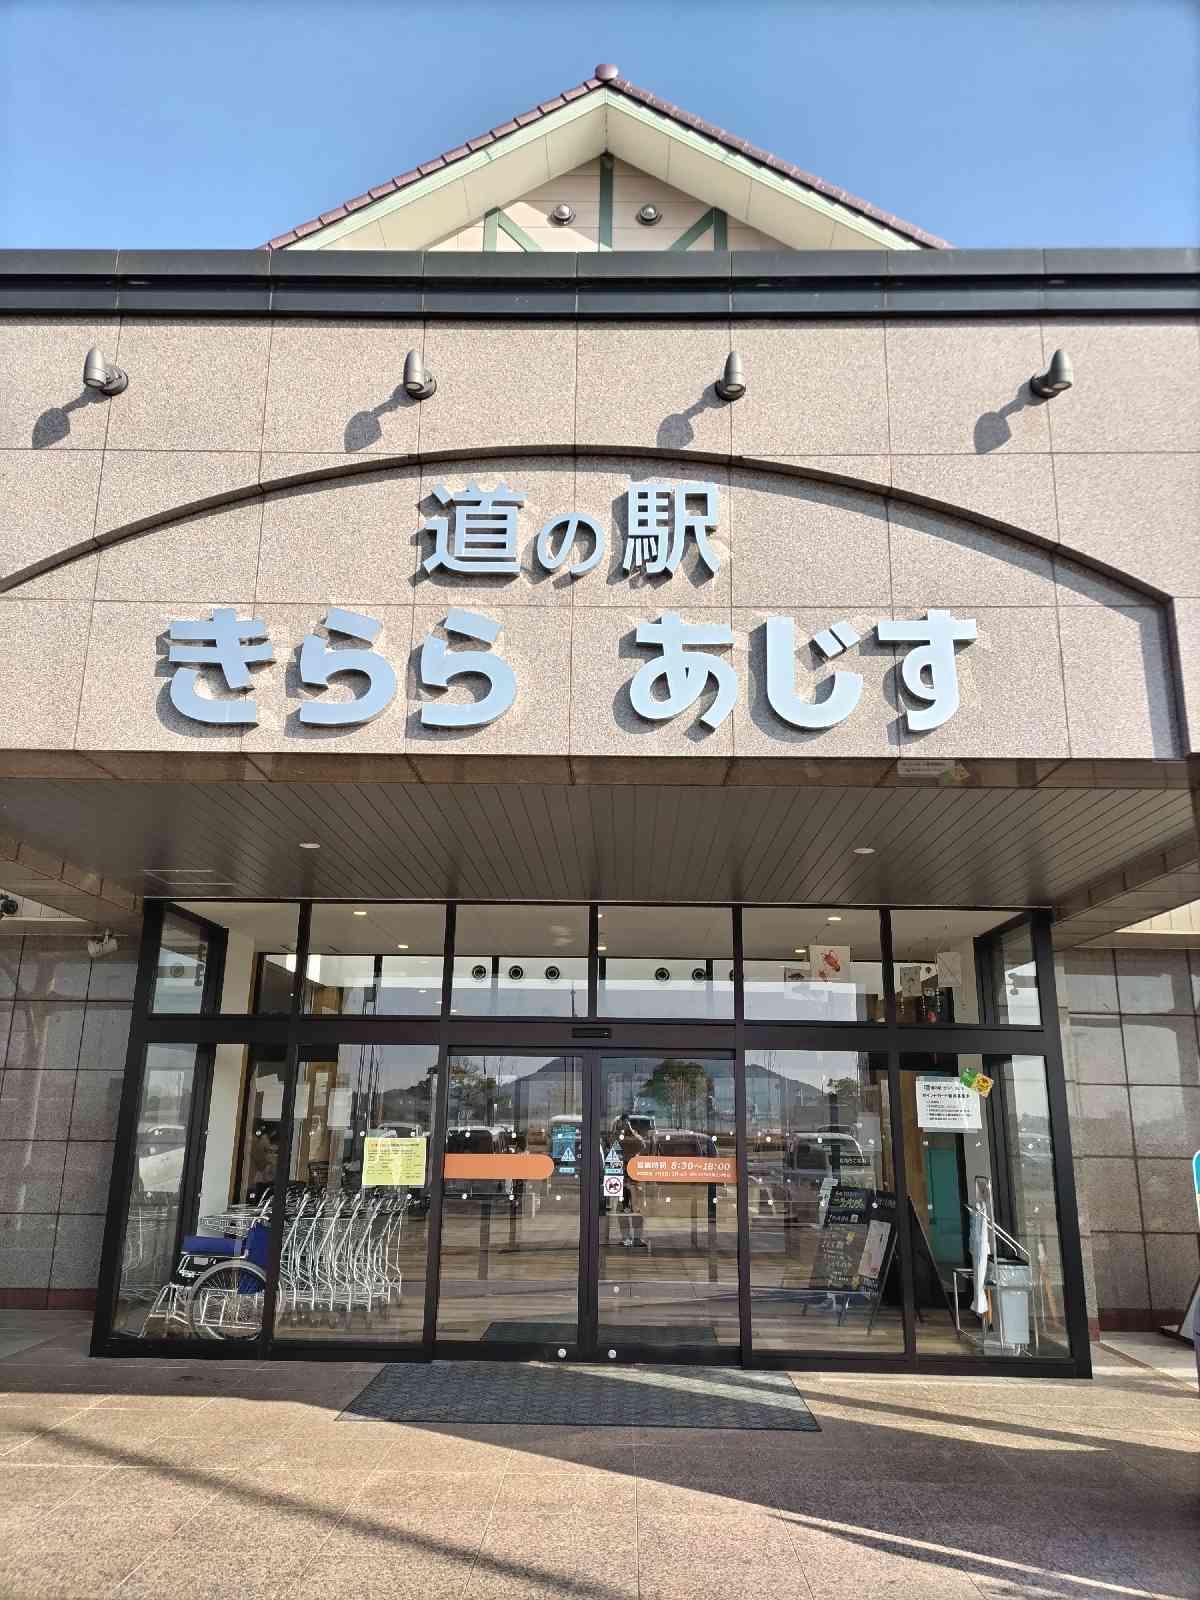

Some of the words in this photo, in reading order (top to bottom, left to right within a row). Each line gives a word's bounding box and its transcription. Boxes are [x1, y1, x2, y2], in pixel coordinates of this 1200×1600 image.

[423, 480, 720, 575] 道の駅
[168, 607, 517, 727] きらら
[630, 608, 977, 732] あじす
